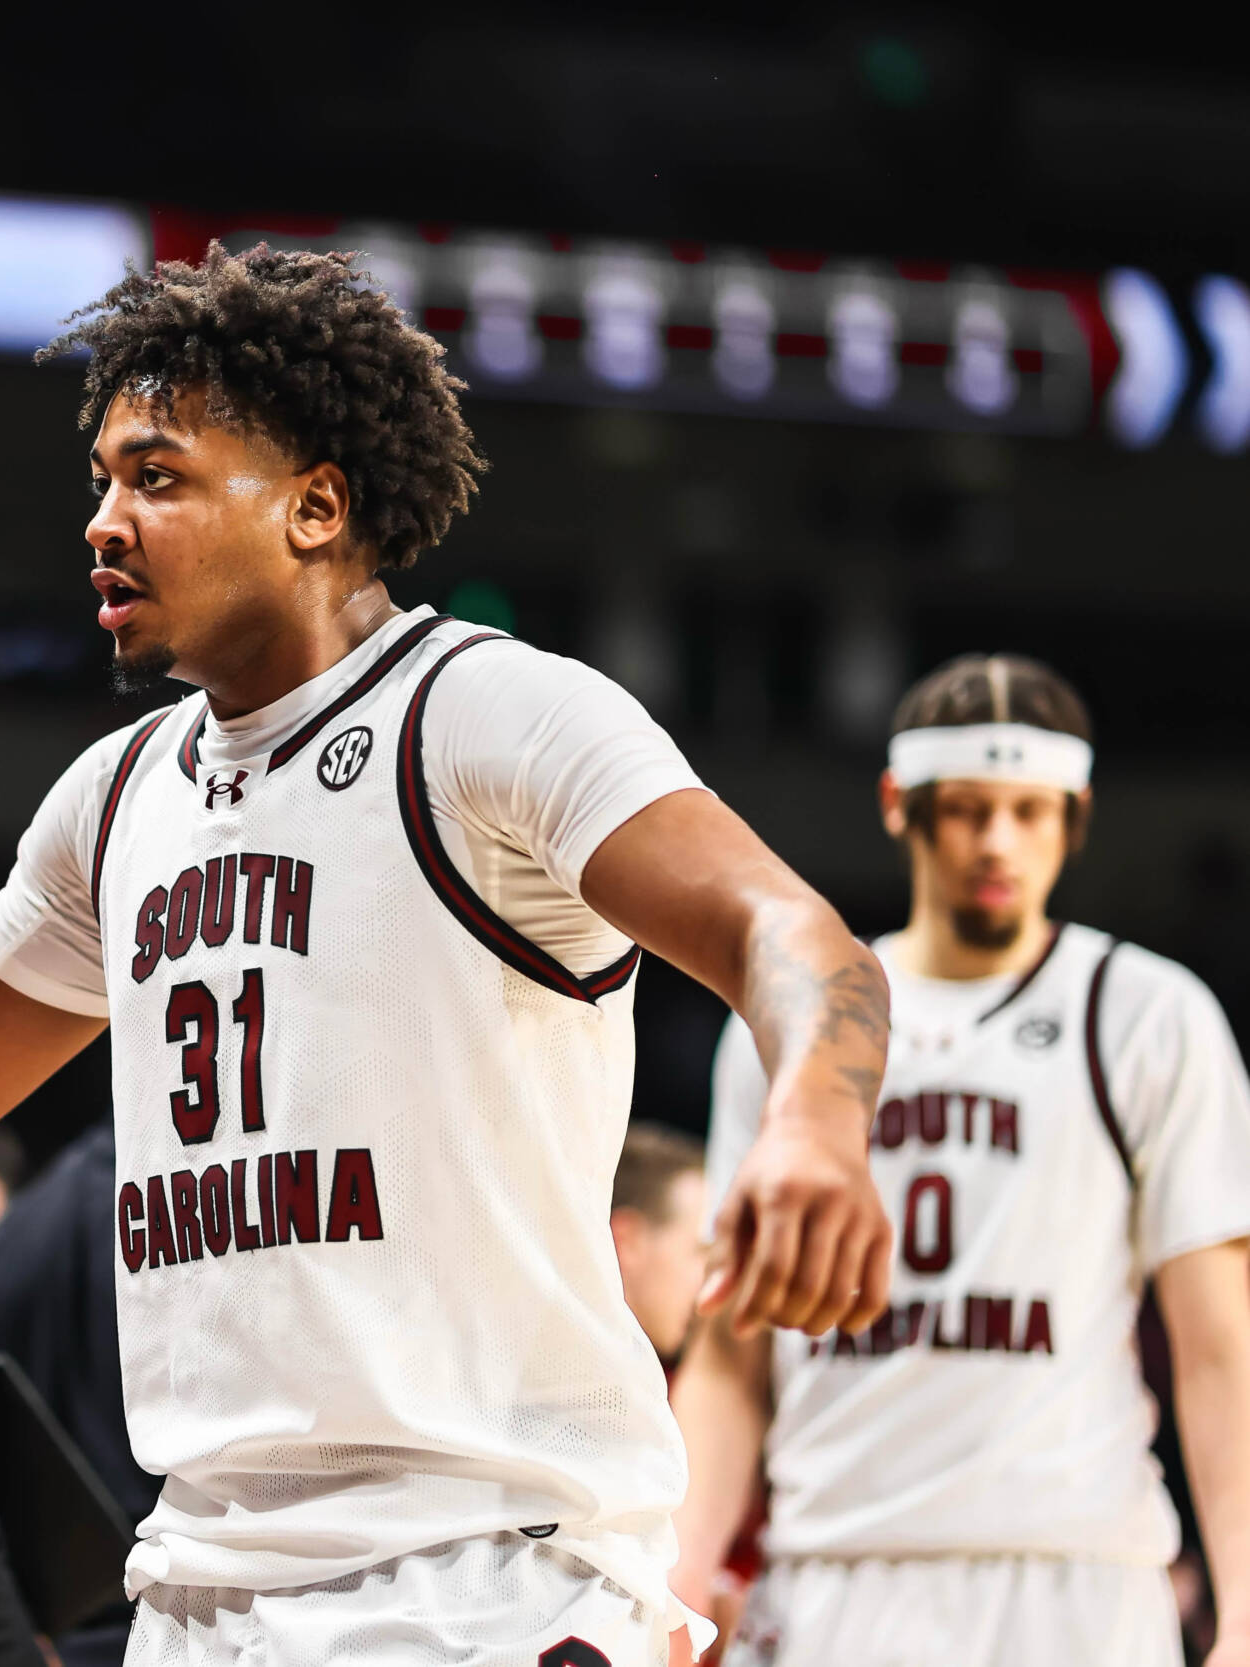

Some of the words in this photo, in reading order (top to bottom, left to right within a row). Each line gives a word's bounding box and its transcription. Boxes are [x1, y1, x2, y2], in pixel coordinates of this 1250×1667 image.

[320, 729, 369, 785] SEC
[131, 852, 314, 984] SOUTH
[166, 967, 266, 1146] 31
[868, 1090, 1019, 1156] OUTH
[119, 1148, 384, 1273] CAROLINA
[902, 1173, 954, 1274] 0
